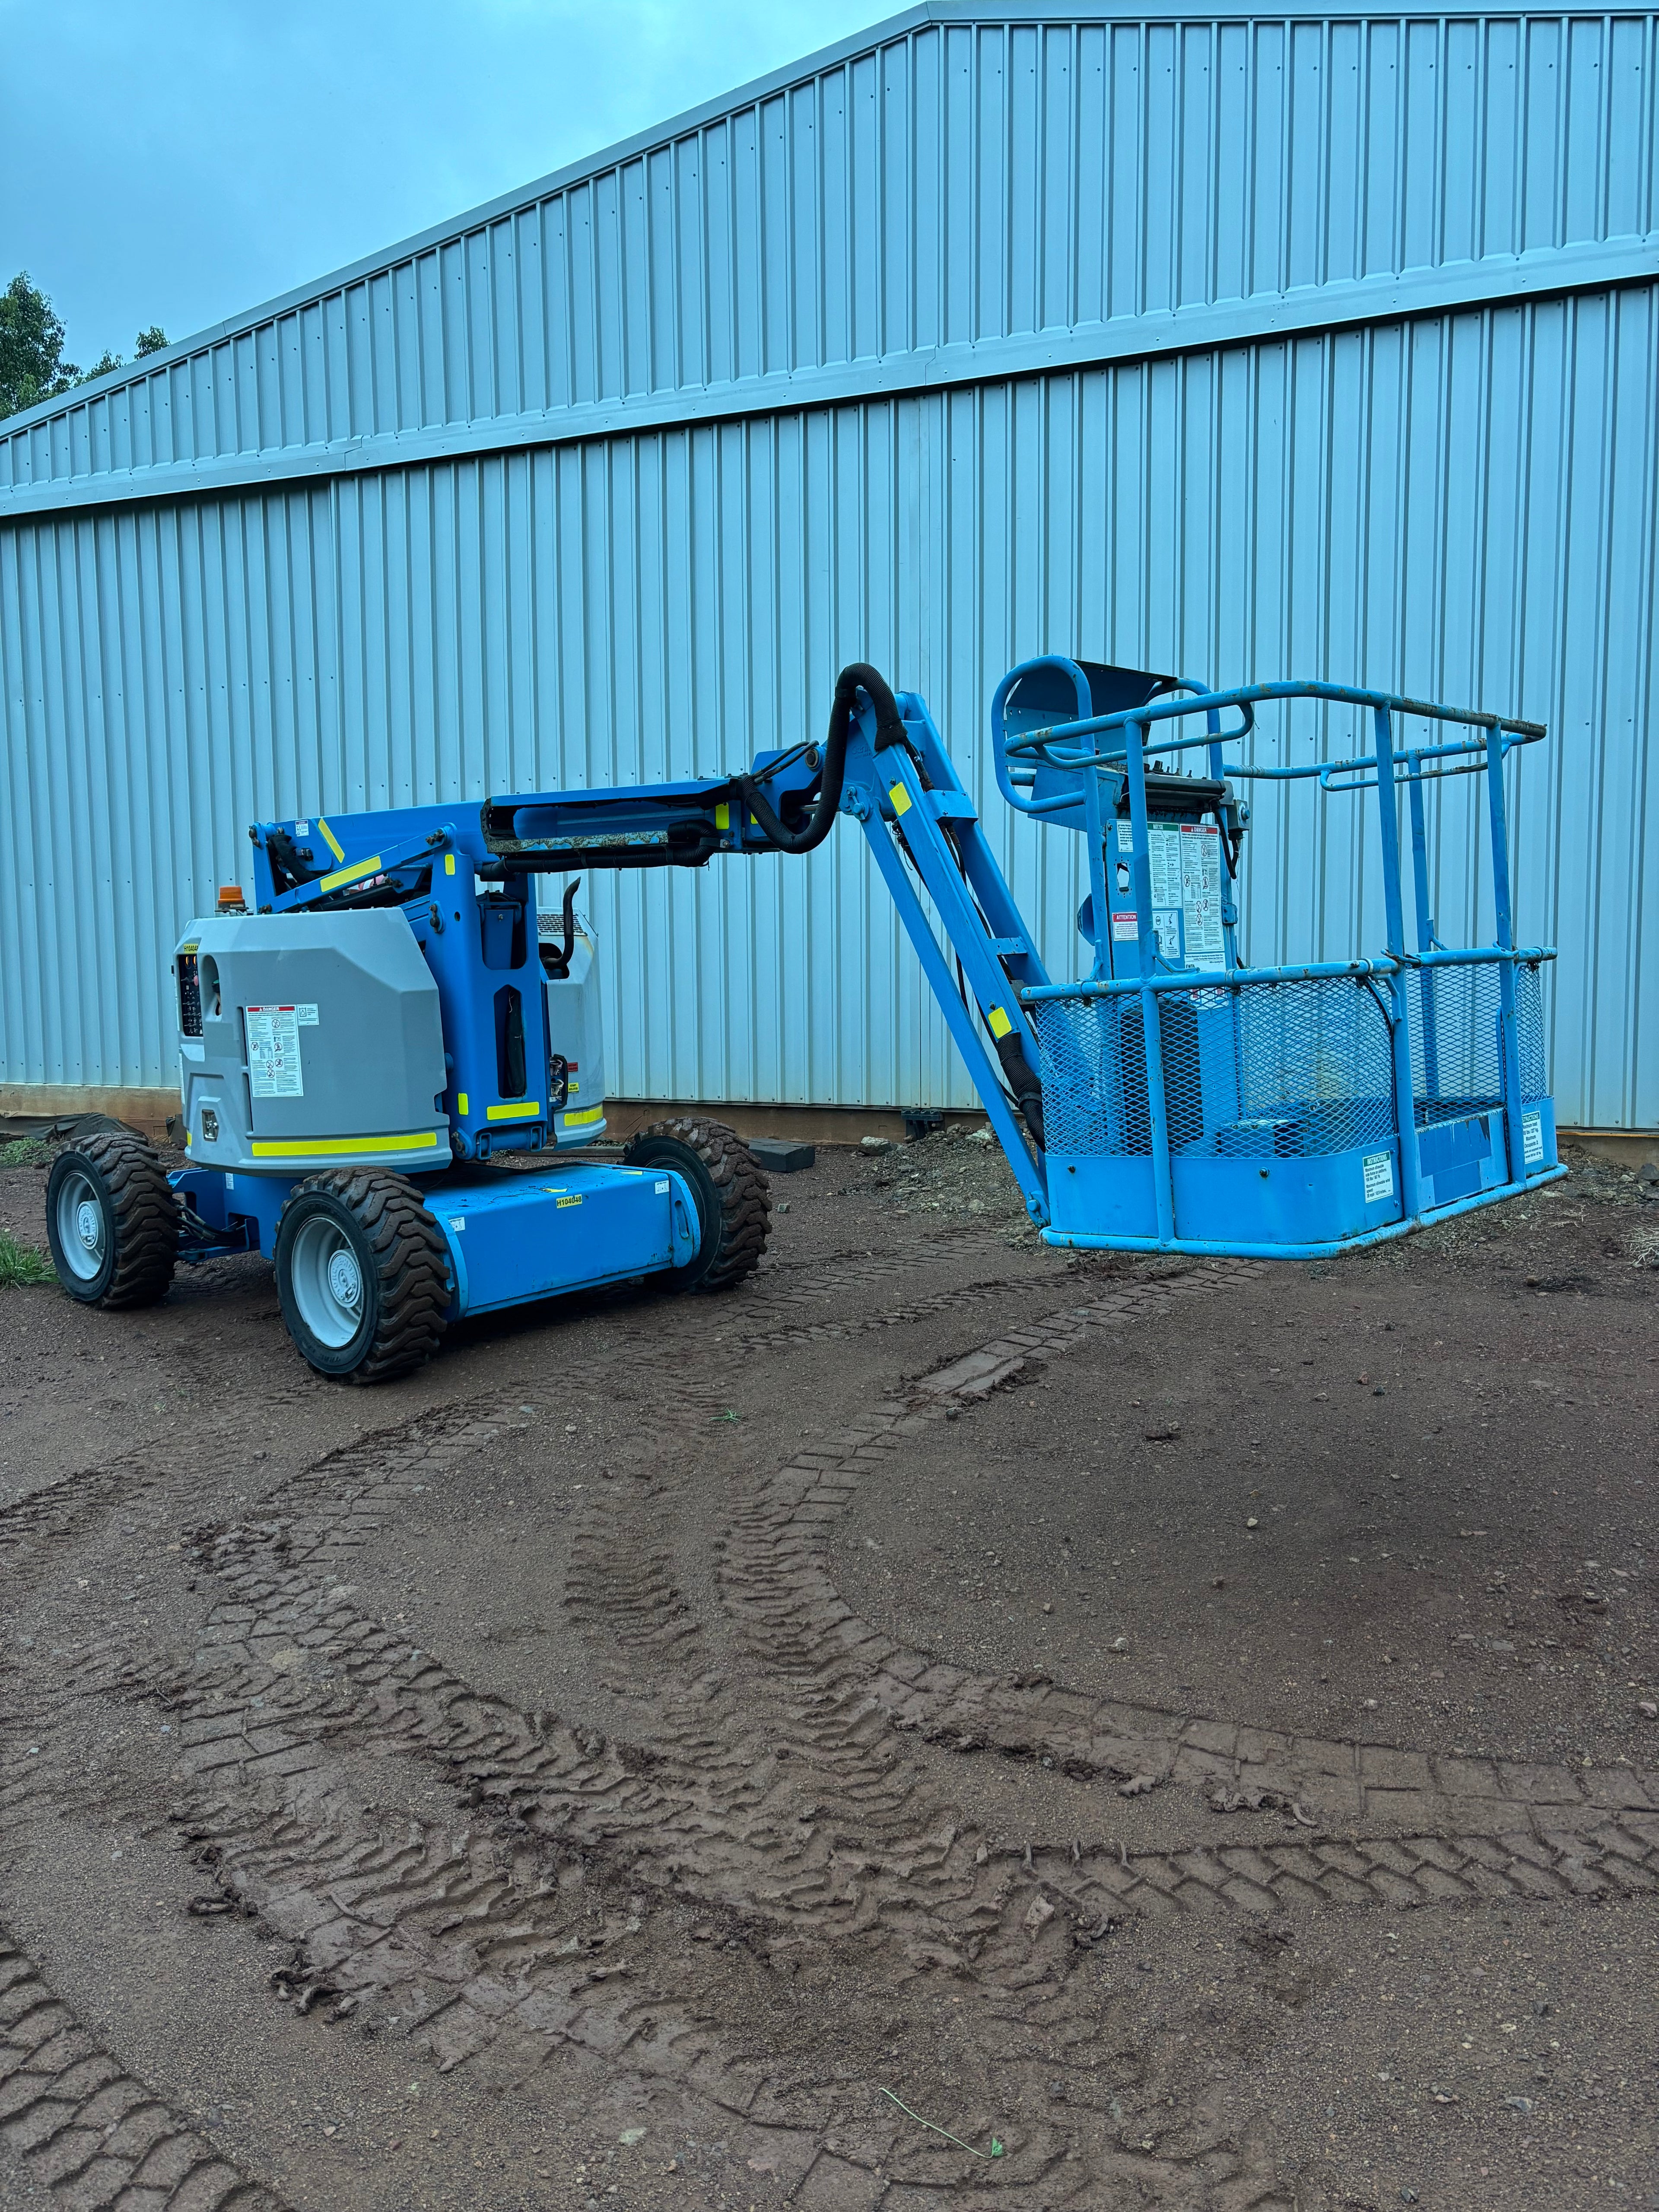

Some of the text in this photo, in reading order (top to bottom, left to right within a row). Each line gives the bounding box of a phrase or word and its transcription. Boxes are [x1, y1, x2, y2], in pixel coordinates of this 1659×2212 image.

[1522, 1113, 1538, 1123] STRUCTIONS
[1367, 1154, 1387, 1165] INSTRUCTIONS
[557, 1196, 582, 1206] H104048
